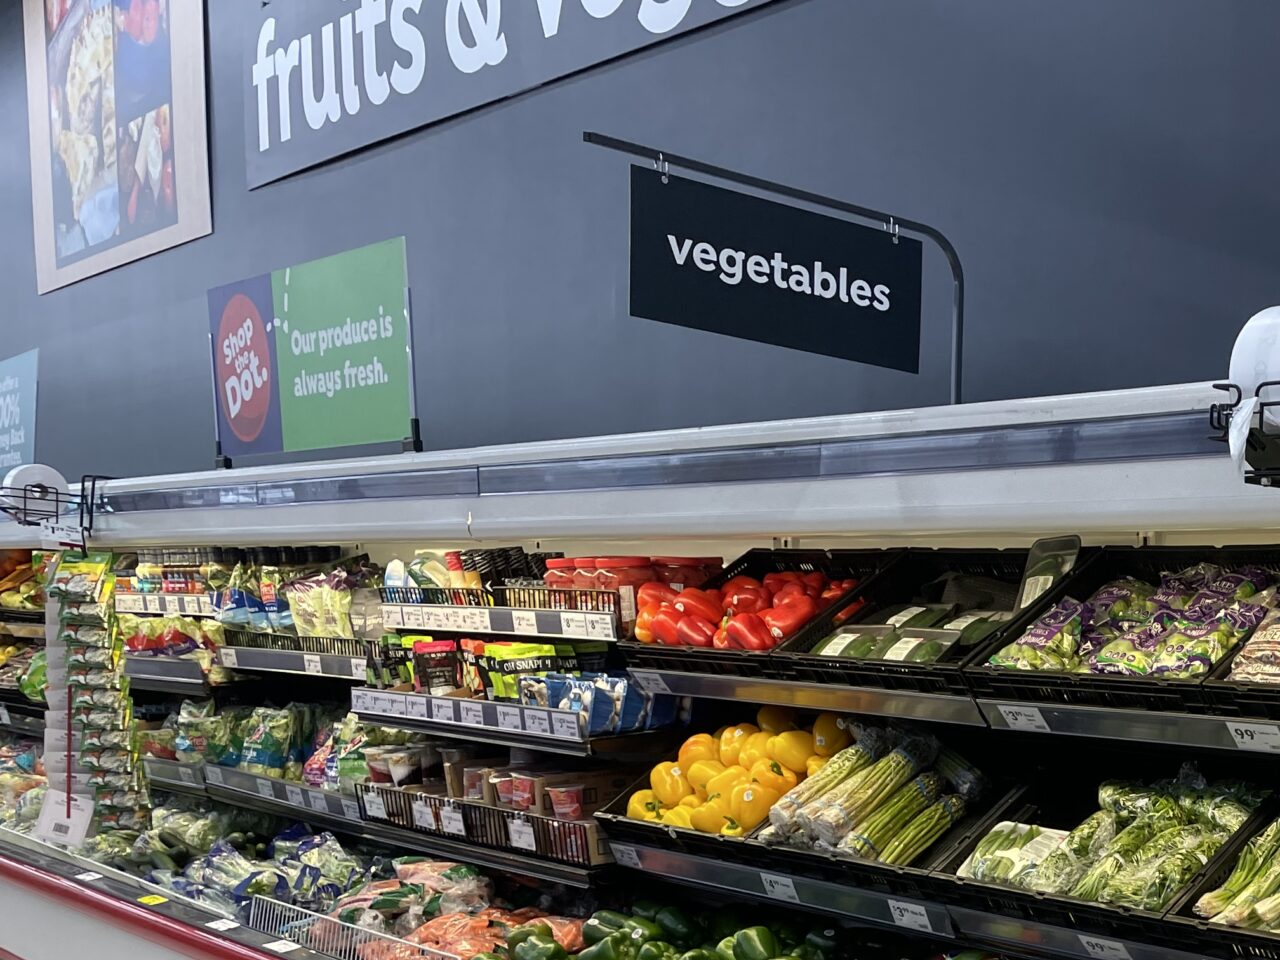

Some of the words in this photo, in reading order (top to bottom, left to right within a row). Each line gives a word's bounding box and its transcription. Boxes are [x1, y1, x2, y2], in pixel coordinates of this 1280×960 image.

[252, 0, 426, 152] fruits
[667, 234, 891, 311] vegetables
[291, 329, 315, 355] Our
[318, 317, 378, 356] produce
[379, 304, 393, 338] is
[234, 351, 249, 374] the
[293, 369, 342, 398] always
[344, 356, 389, 389] fresh.
